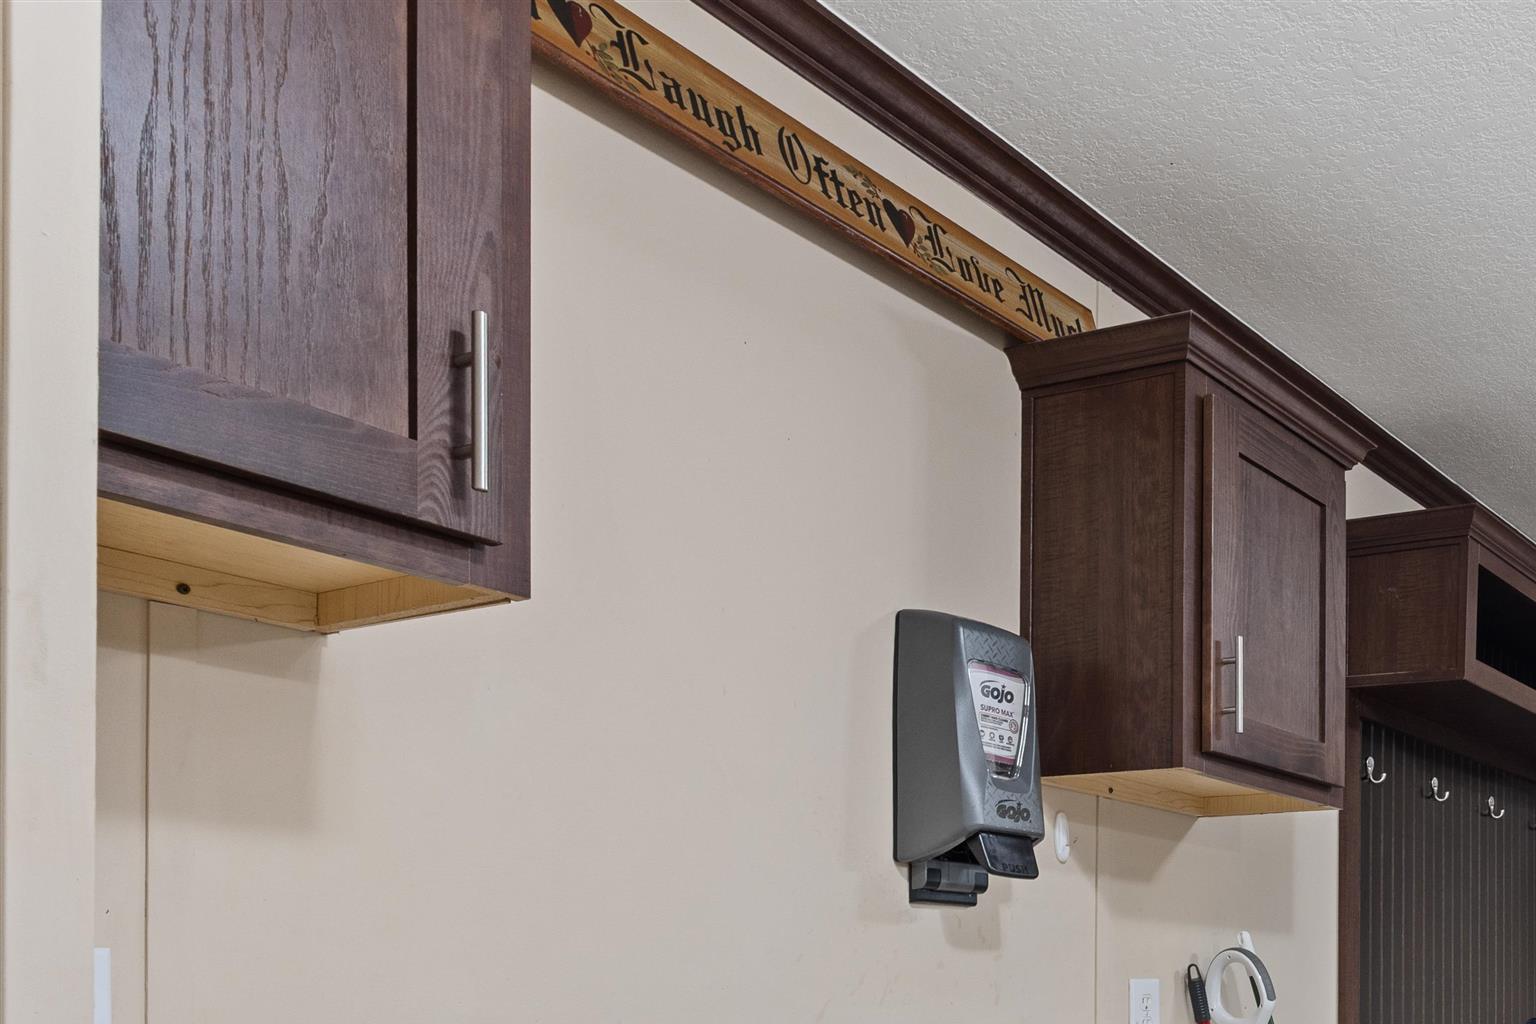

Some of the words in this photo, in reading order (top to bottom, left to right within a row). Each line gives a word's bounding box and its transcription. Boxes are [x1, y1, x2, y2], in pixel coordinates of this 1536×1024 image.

[589, 3, 763, 156] Laugh
[778, 126, 886, 232] Often
[908, 205, 1005, 302] Love
[980, 704, 1000, 714] SUPRO
[1001, 709, 1014, 719] MAX
[1002, 863, 1030, 873] PUSH
